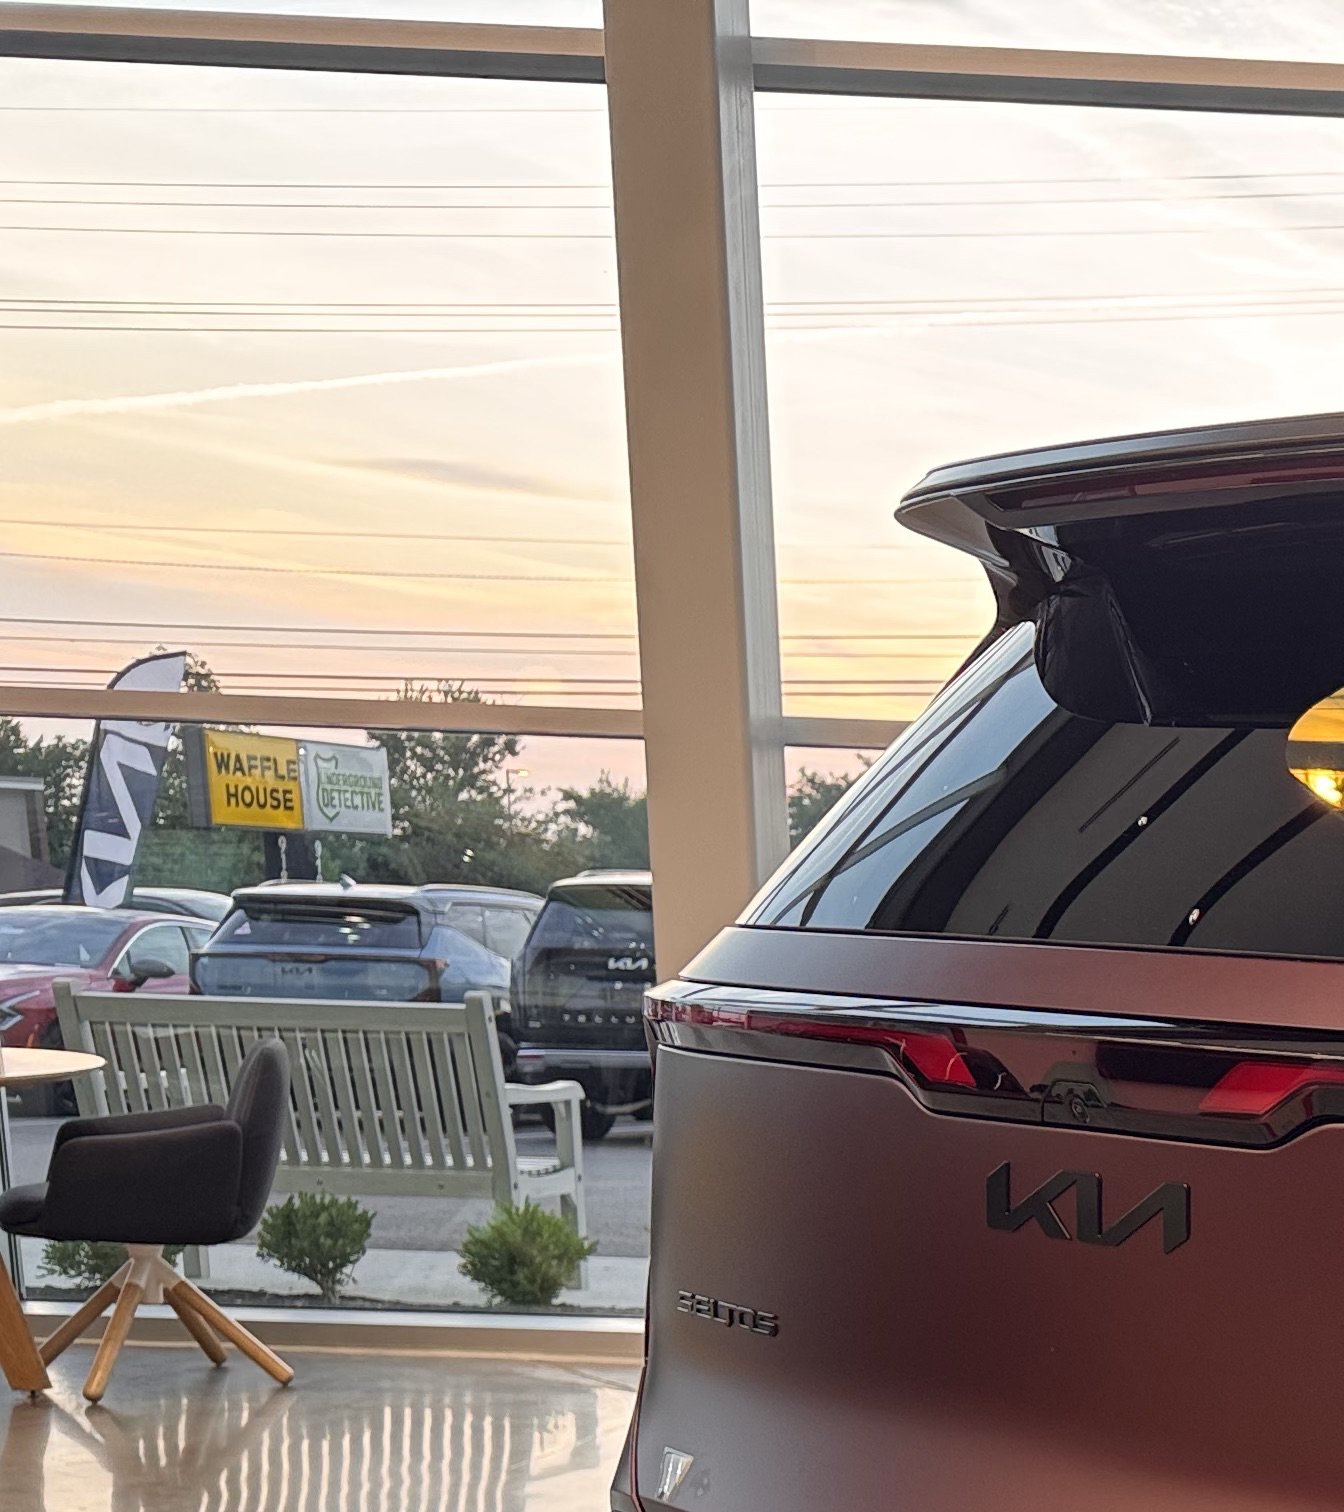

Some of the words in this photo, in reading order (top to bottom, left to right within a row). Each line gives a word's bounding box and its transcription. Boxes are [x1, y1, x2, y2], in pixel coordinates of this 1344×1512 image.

[214, 752, 298, 781] WAFFLE
[225, 783, 295, 811] HOUSE
[321, 788, 385, 812] DETECTIVE
[985, 1160, 1191, 1254] KIA
[677, 1289, 779, 1337] SELTOS
